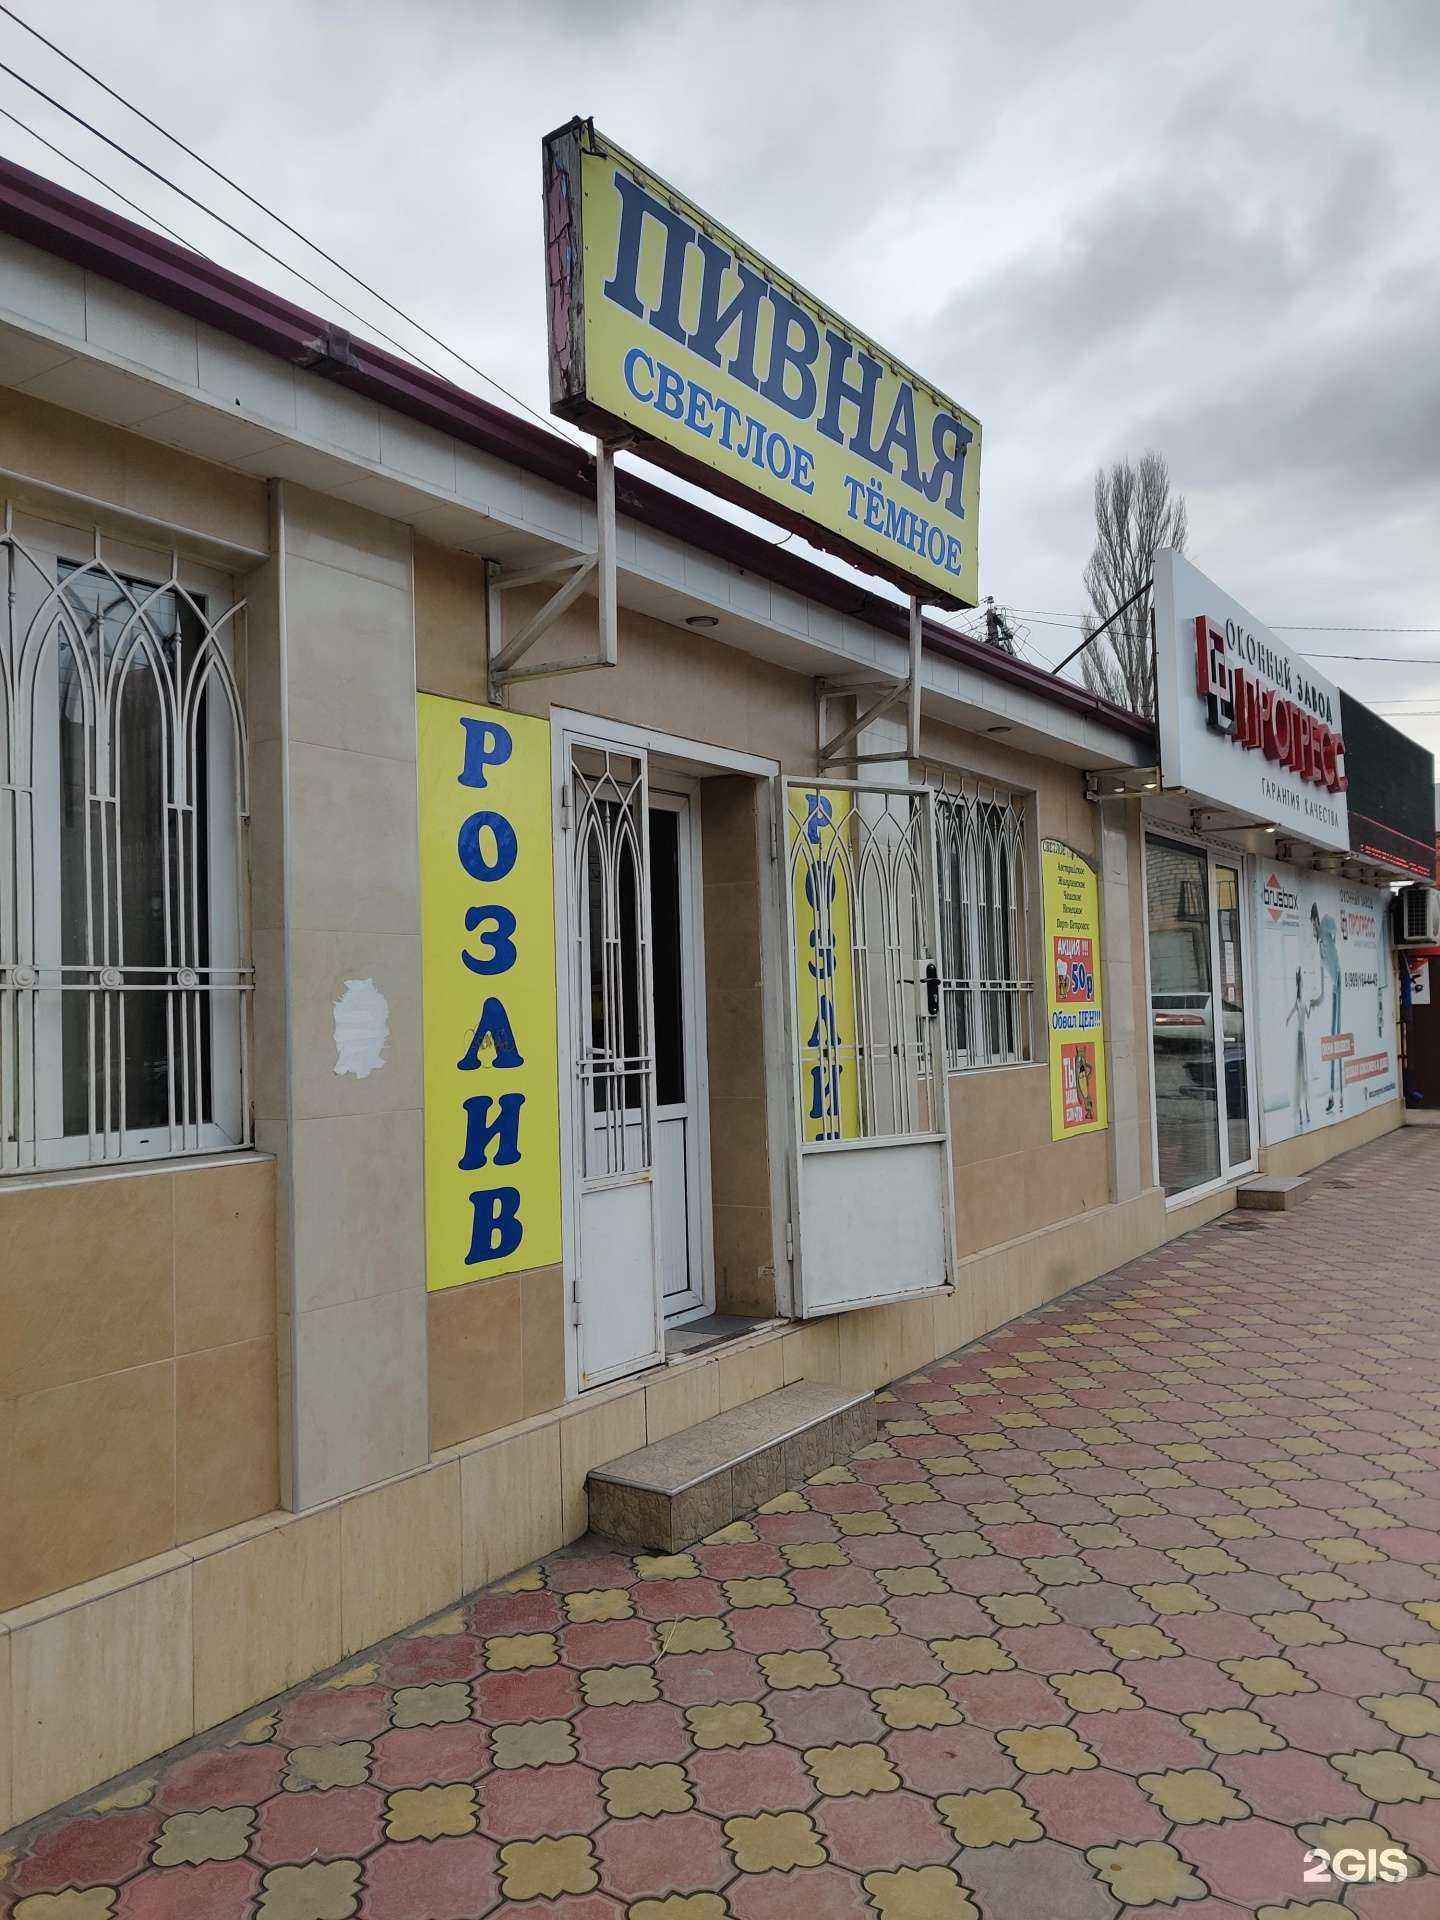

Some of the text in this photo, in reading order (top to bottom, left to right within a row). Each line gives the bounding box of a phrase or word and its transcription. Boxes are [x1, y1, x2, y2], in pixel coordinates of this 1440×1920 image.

[603, 171, 974, 520] ПИВНАЯ
[623, 346, 963, 577] СВЕТЛОЕ ТЁМНОЕ
[1225, 617, 1333, 726] ОКОННЫЙ ЗАВОД
[1231, 667, 1349, 794] ПРОГРЕСС
[1261, 777, 1340, 828] ГАРАНТИЯ КАЧЕСТВА
[804, 792, 842, 1141] РОЗЛИ
[1057, 938, 1081, 959] АКЦИЯ
